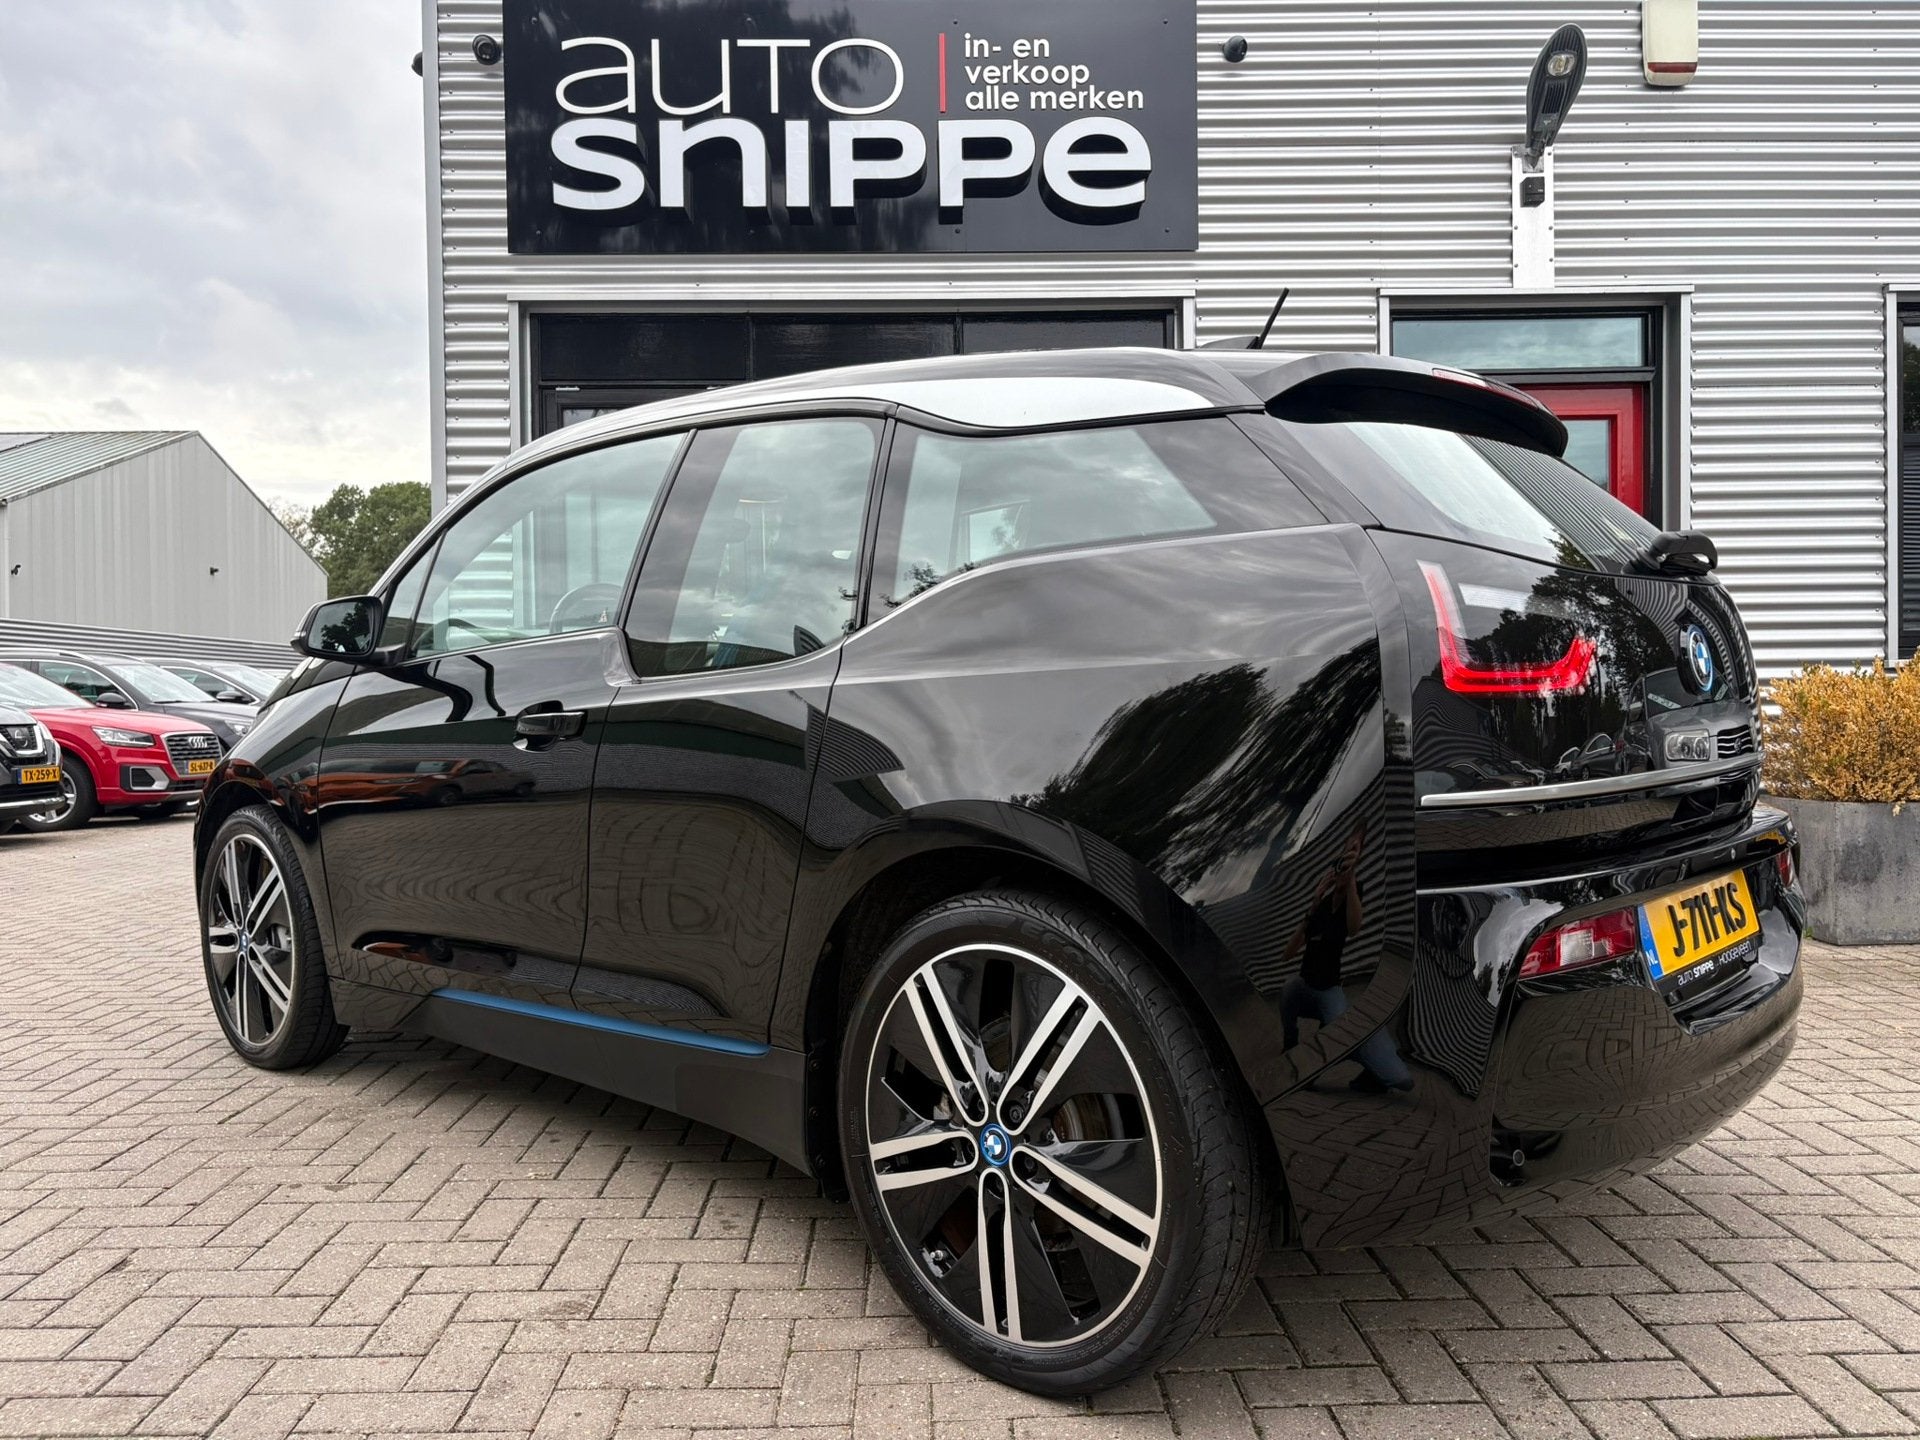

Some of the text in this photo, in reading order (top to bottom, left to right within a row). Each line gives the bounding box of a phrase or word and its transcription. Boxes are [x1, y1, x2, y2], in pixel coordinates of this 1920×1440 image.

[964, 32, 1050, 58] in- en
[964, 59, 1090, 89] verkoop
[965, 84, 1144, 110] alle merken
[23, 769, 57, 782] TX-259-X
[1667, 882, 1747, 957] J-711-KS
[1645, 949, 1659, 966] NL
